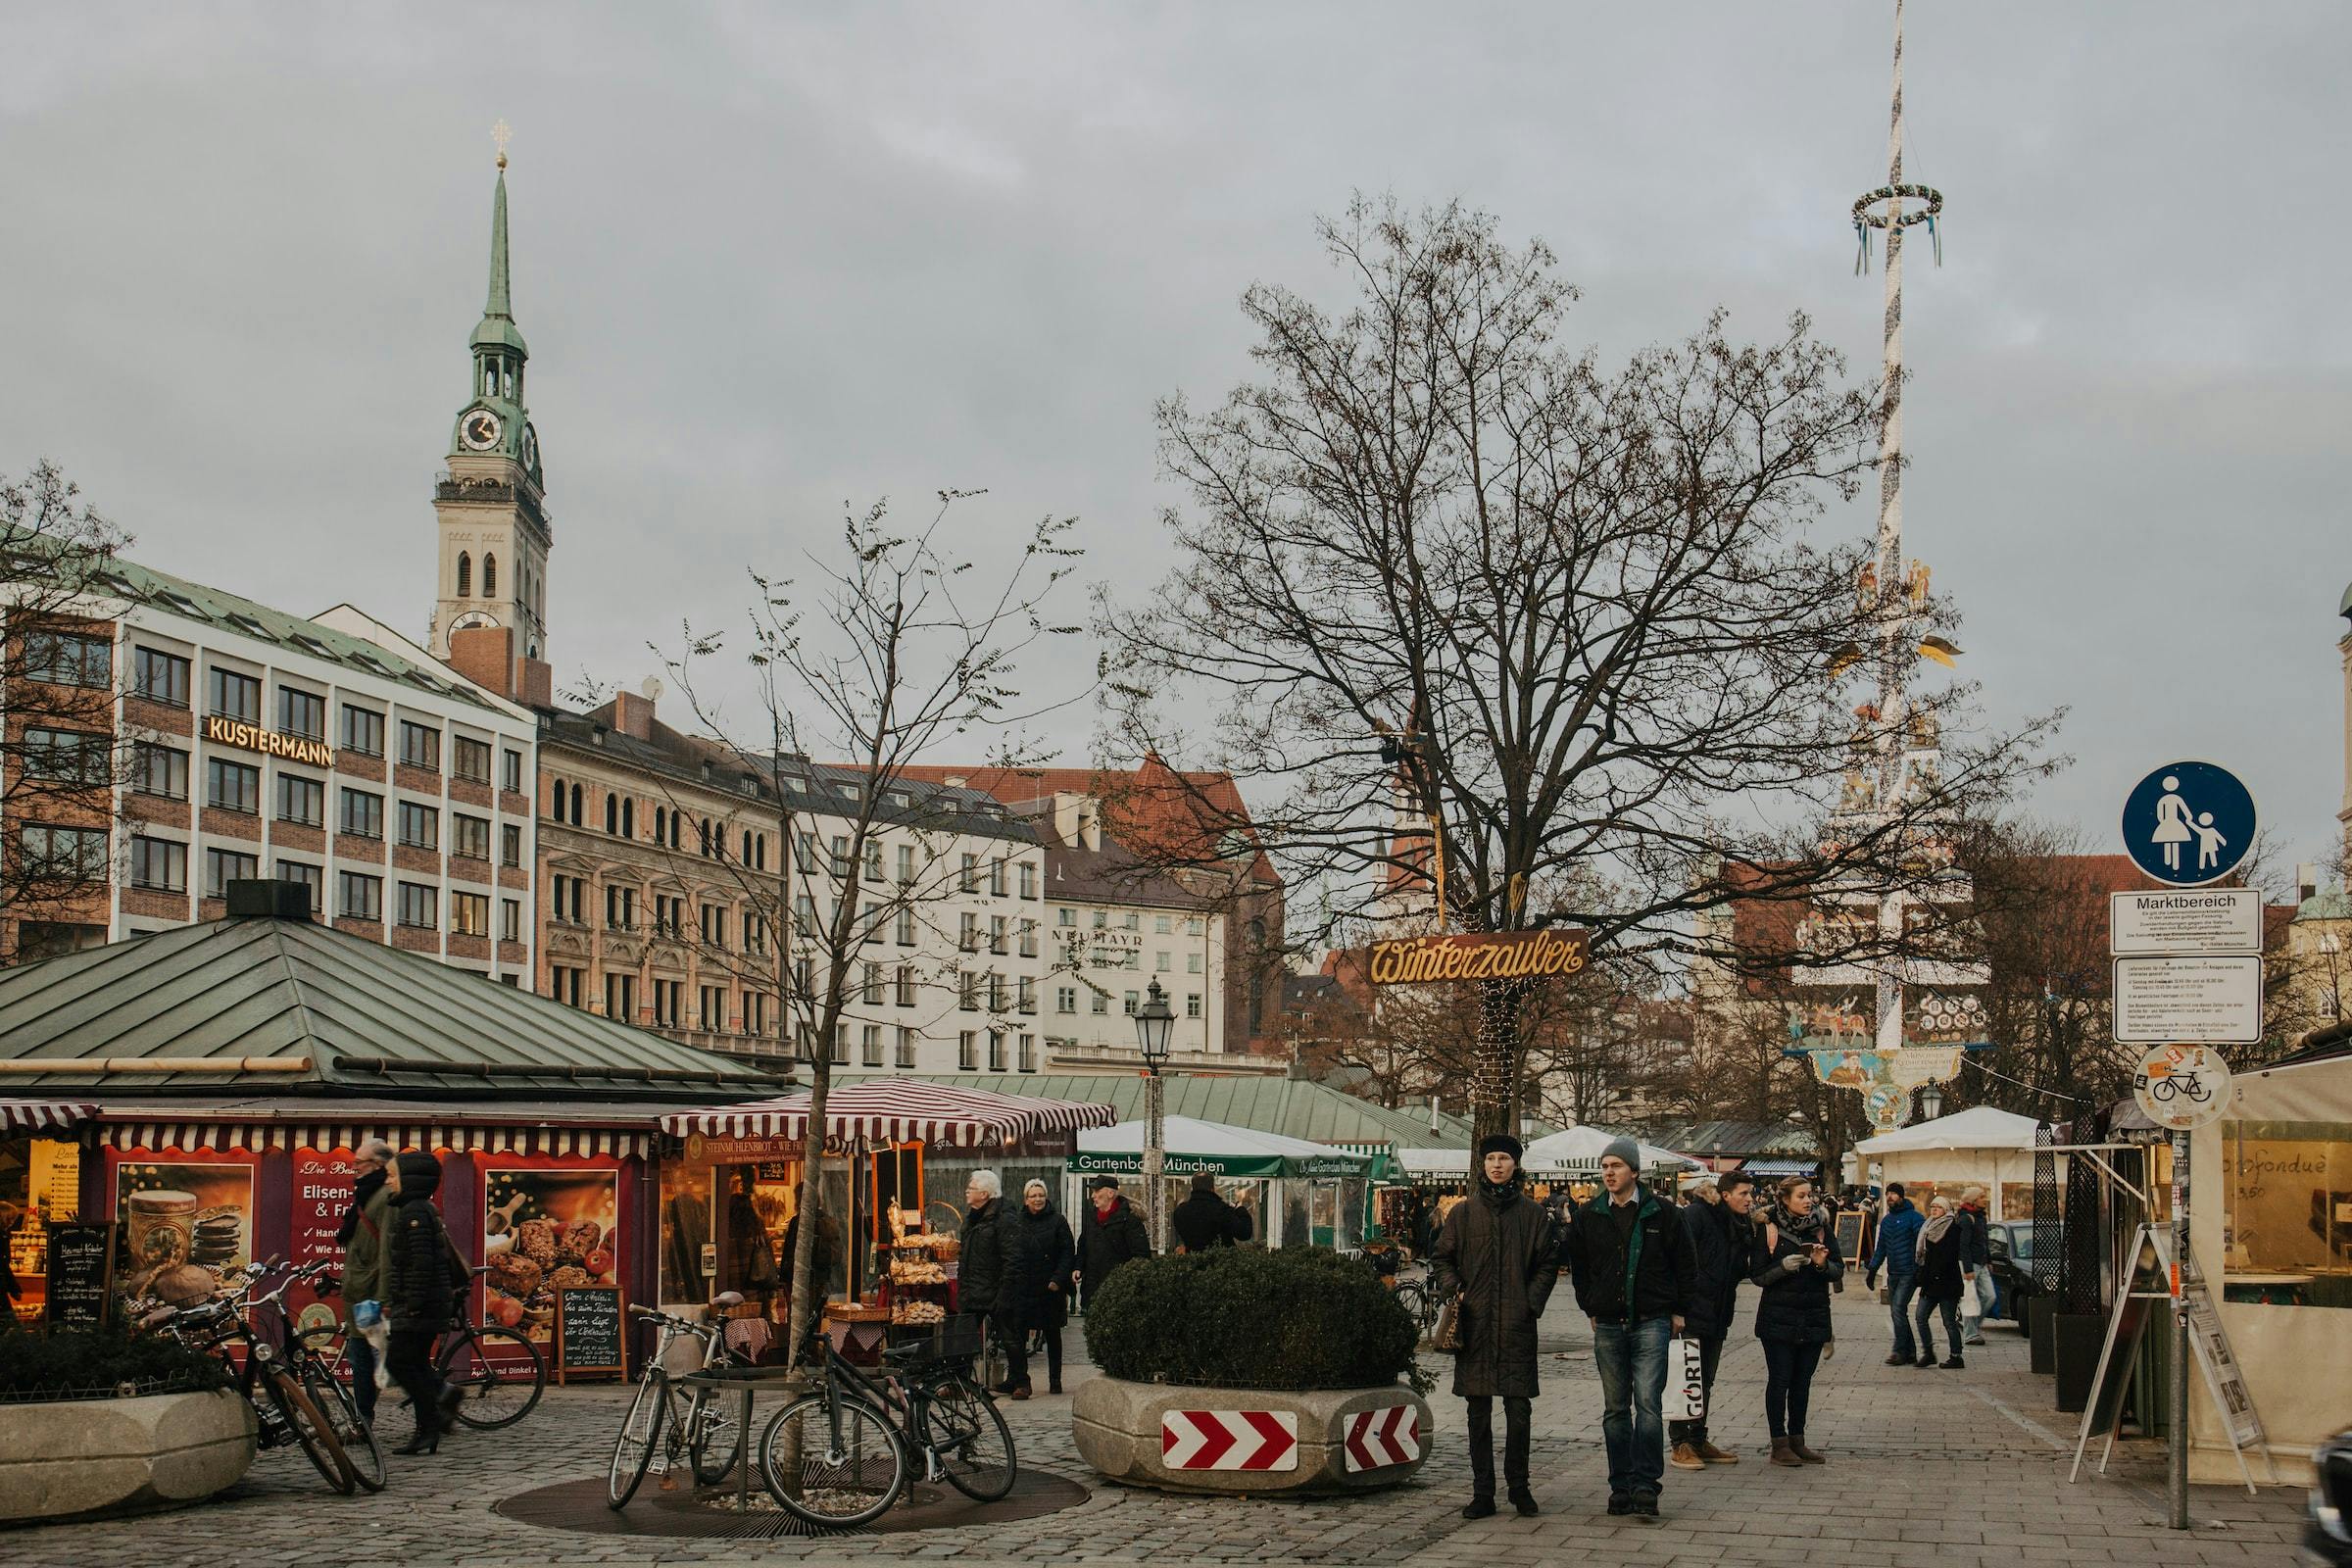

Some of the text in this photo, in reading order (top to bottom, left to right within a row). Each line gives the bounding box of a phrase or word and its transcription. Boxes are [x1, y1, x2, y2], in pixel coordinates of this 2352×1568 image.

[210, 716, 332, 767] KUSTERMANN
[2136, 895, 2236, 909] Marktbereich
[1052, 930, 1142, 946] NEUMAYR
[1372, 931, 1583, 983] Winterzauber
[706, 1141, 772, 1153] STEINMÜHLENBROT
[778, 1141, 791, 1152] WIE
[1079, 1155, 1143, 1170] Gartenba
[303, 1185, 353, 1199] Elisen-
[315, 1202, 328, 1217] &
[316, 1227, 339, 1237] Hand
[315, 1245, 332, 1254] Wie
[333, 1261, 345, 1270] be
